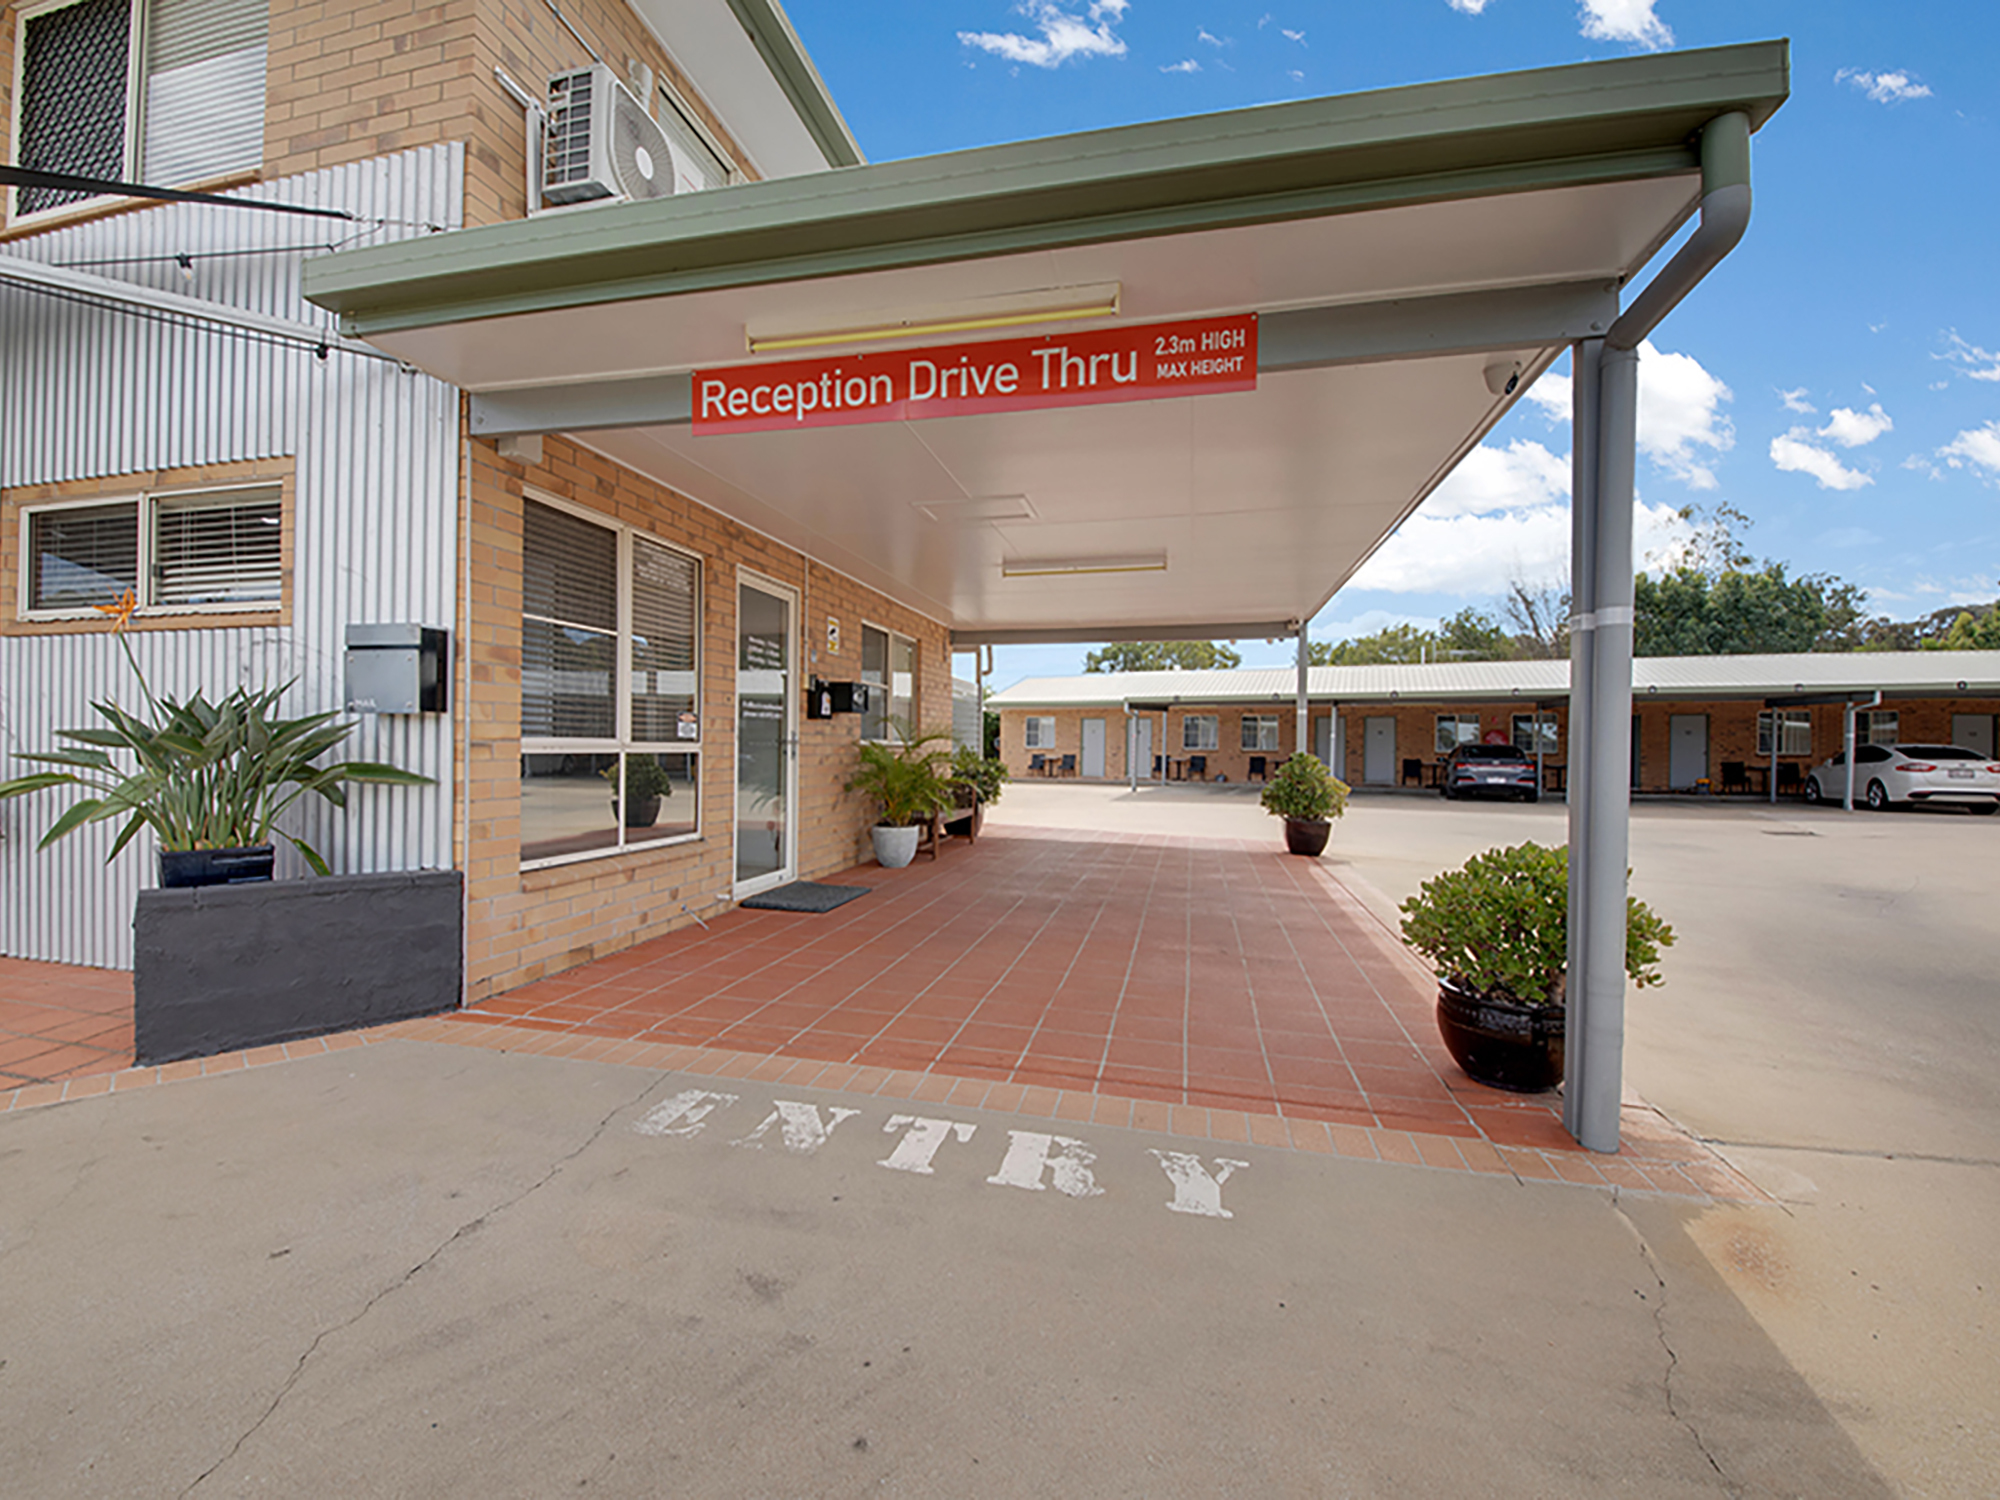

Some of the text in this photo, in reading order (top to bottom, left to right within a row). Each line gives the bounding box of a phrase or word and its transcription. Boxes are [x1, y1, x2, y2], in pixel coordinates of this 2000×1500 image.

[1155, 328, 1245, 356] 2.3m HIGH
[1156, 356, 1244, 379] MAX HEIGHT
[700, 346, 1138, 422] Reception Drive Thru
[631, 1088, 1250, 1219] ENTRY
